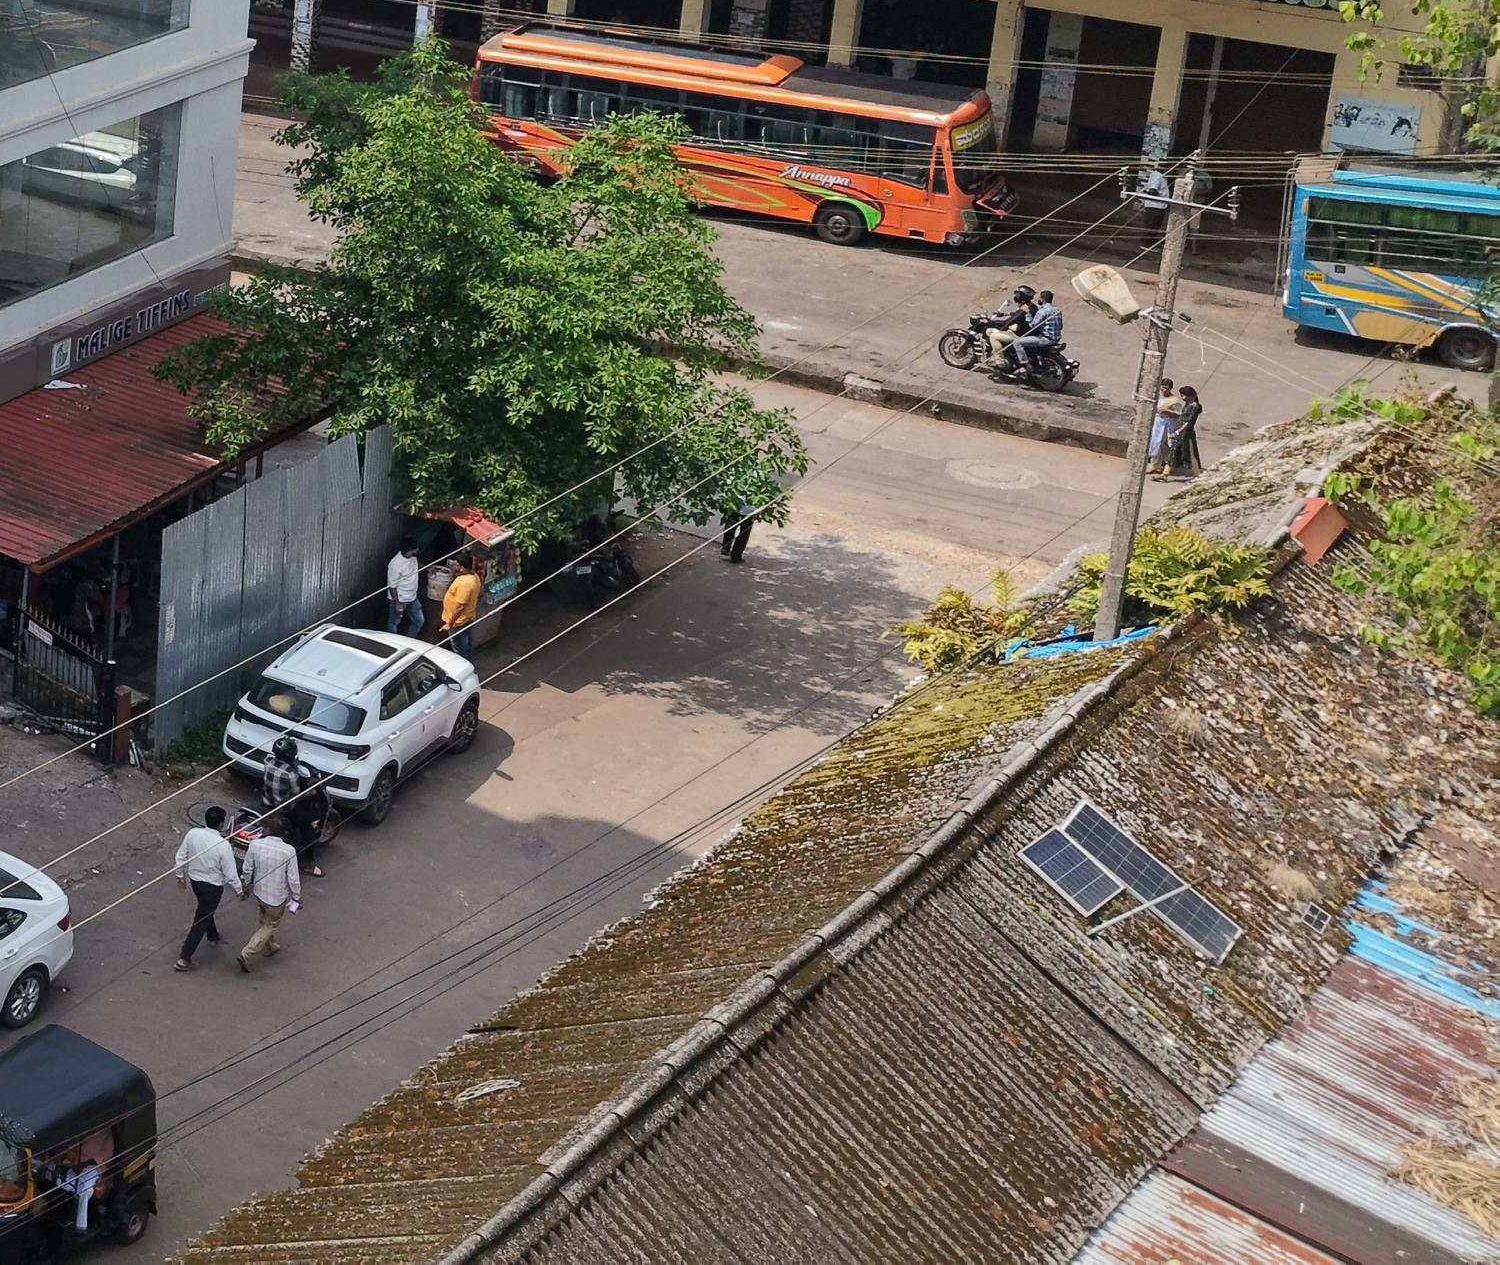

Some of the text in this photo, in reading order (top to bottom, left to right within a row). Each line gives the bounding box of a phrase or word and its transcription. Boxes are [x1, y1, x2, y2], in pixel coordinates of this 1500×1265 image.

[778, 163, 852, 188] Annappa
[76, 314, 133, 362] MALIGE
[136, 289, 190, 334] TIFFINS
